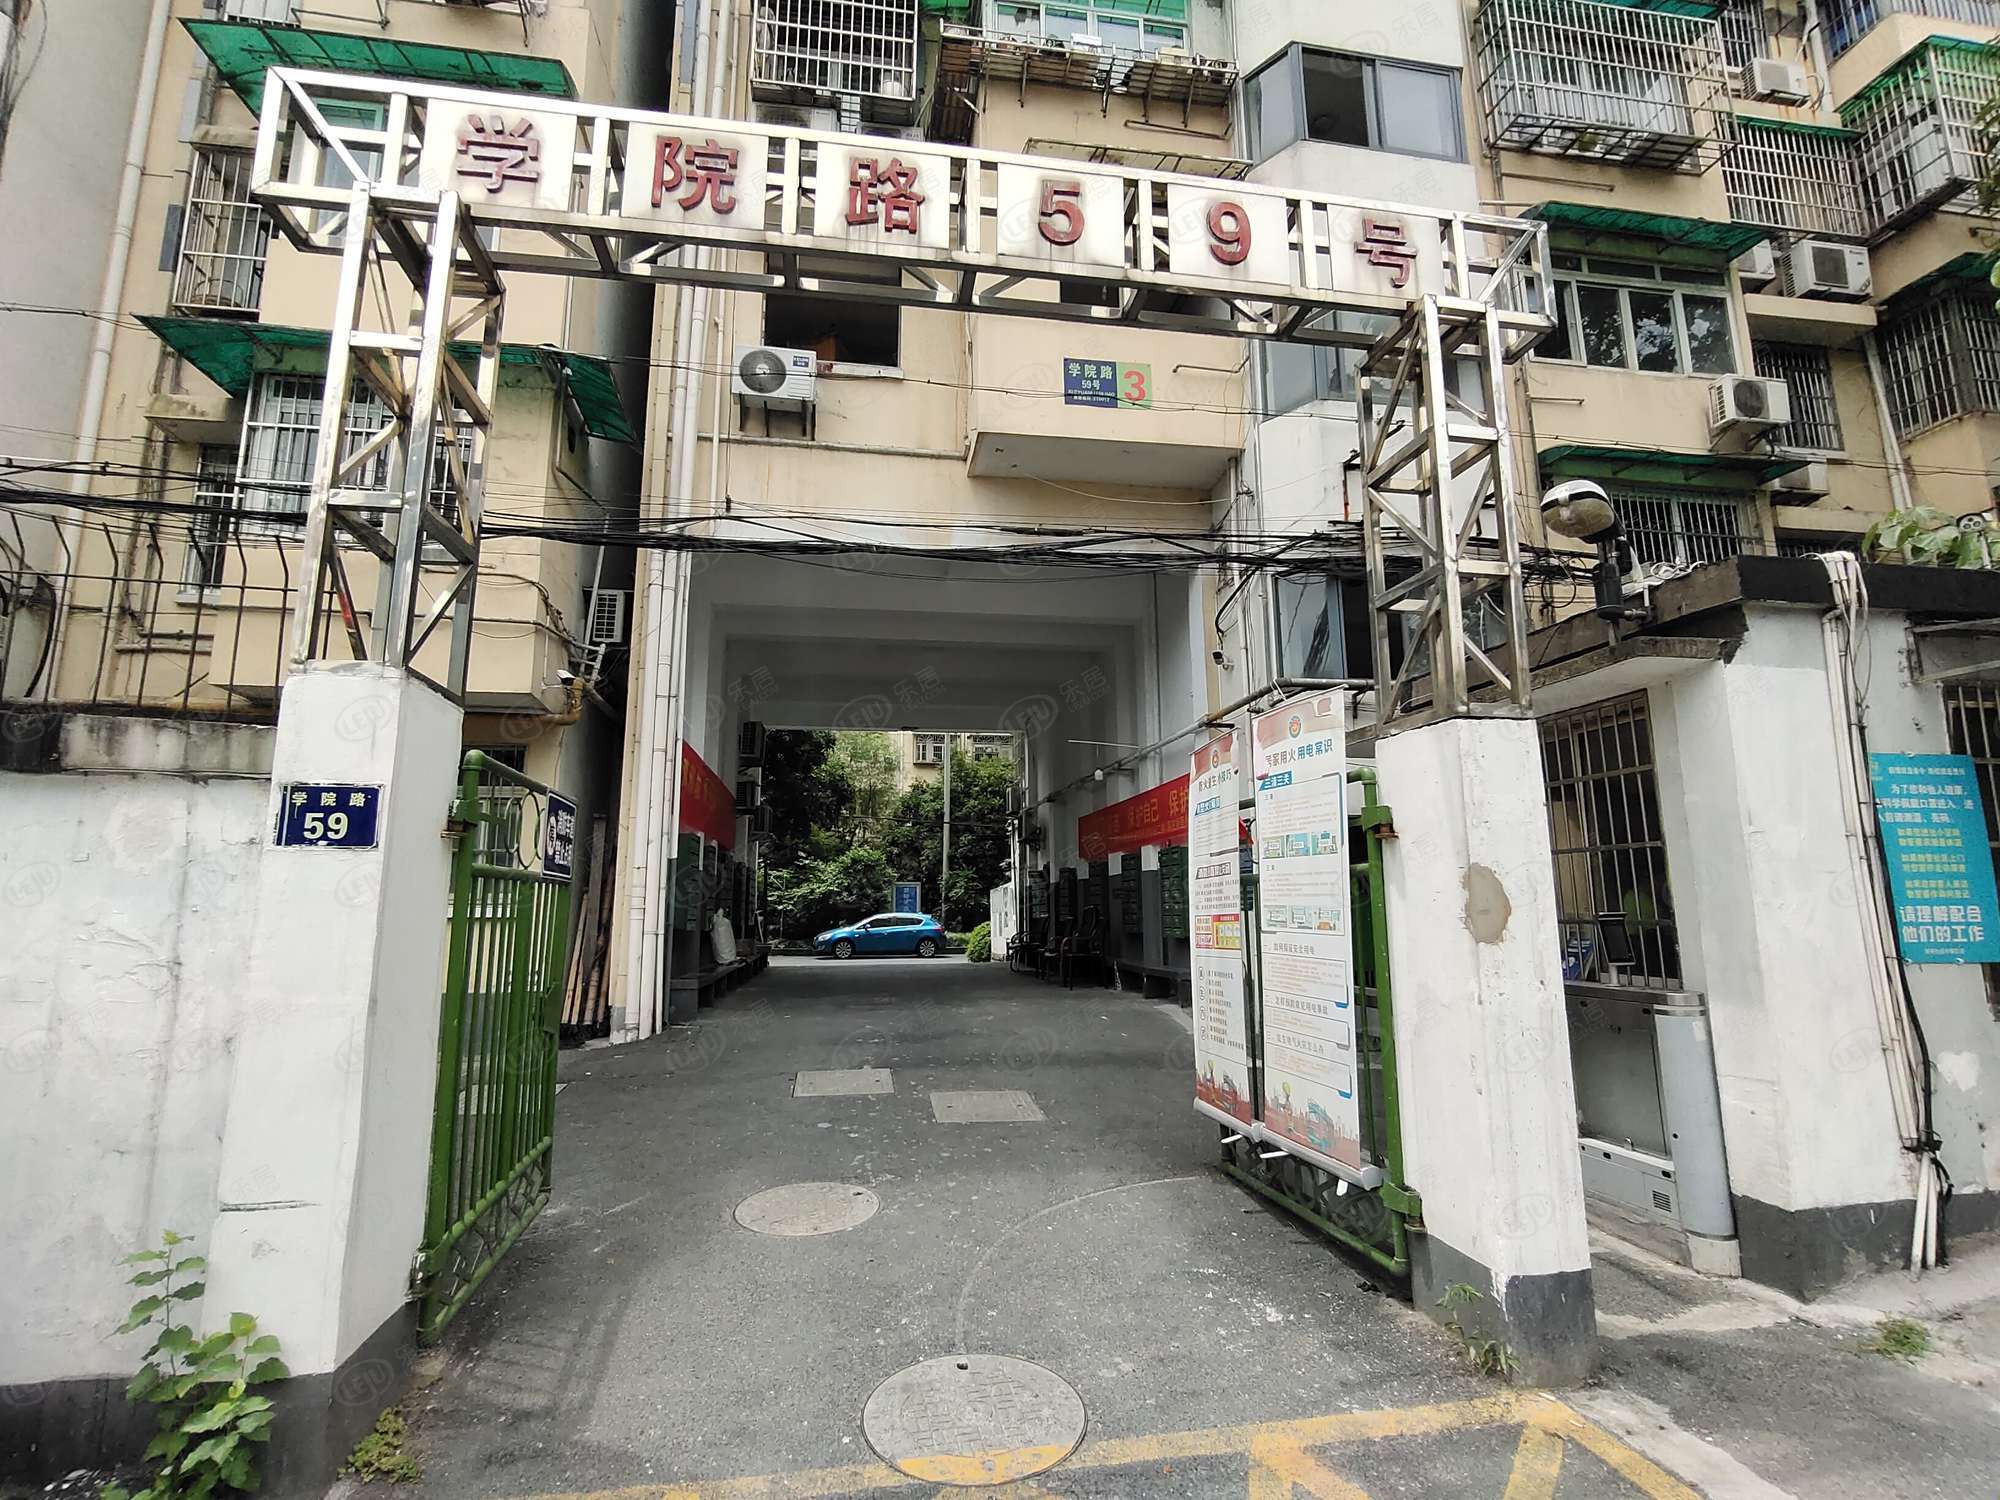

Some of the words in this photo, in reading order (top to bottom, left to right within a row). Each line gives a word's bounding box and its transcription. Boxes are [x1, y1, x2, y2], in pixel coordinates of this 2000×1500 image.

[456, 113, 1417, 288] 学院路59号
[1068, 362, 1113, 379] 学院路
[1081, 379, 1101, 390] 59号
[1124, 370, 1146, 401] 3
[291, 791, 366, 807] 学院路
[303, 812, 349, 840] 59
[1901, 906, 1982, 922] 请理解配合
[1903, 925, 1985, 943] 他们的工作
